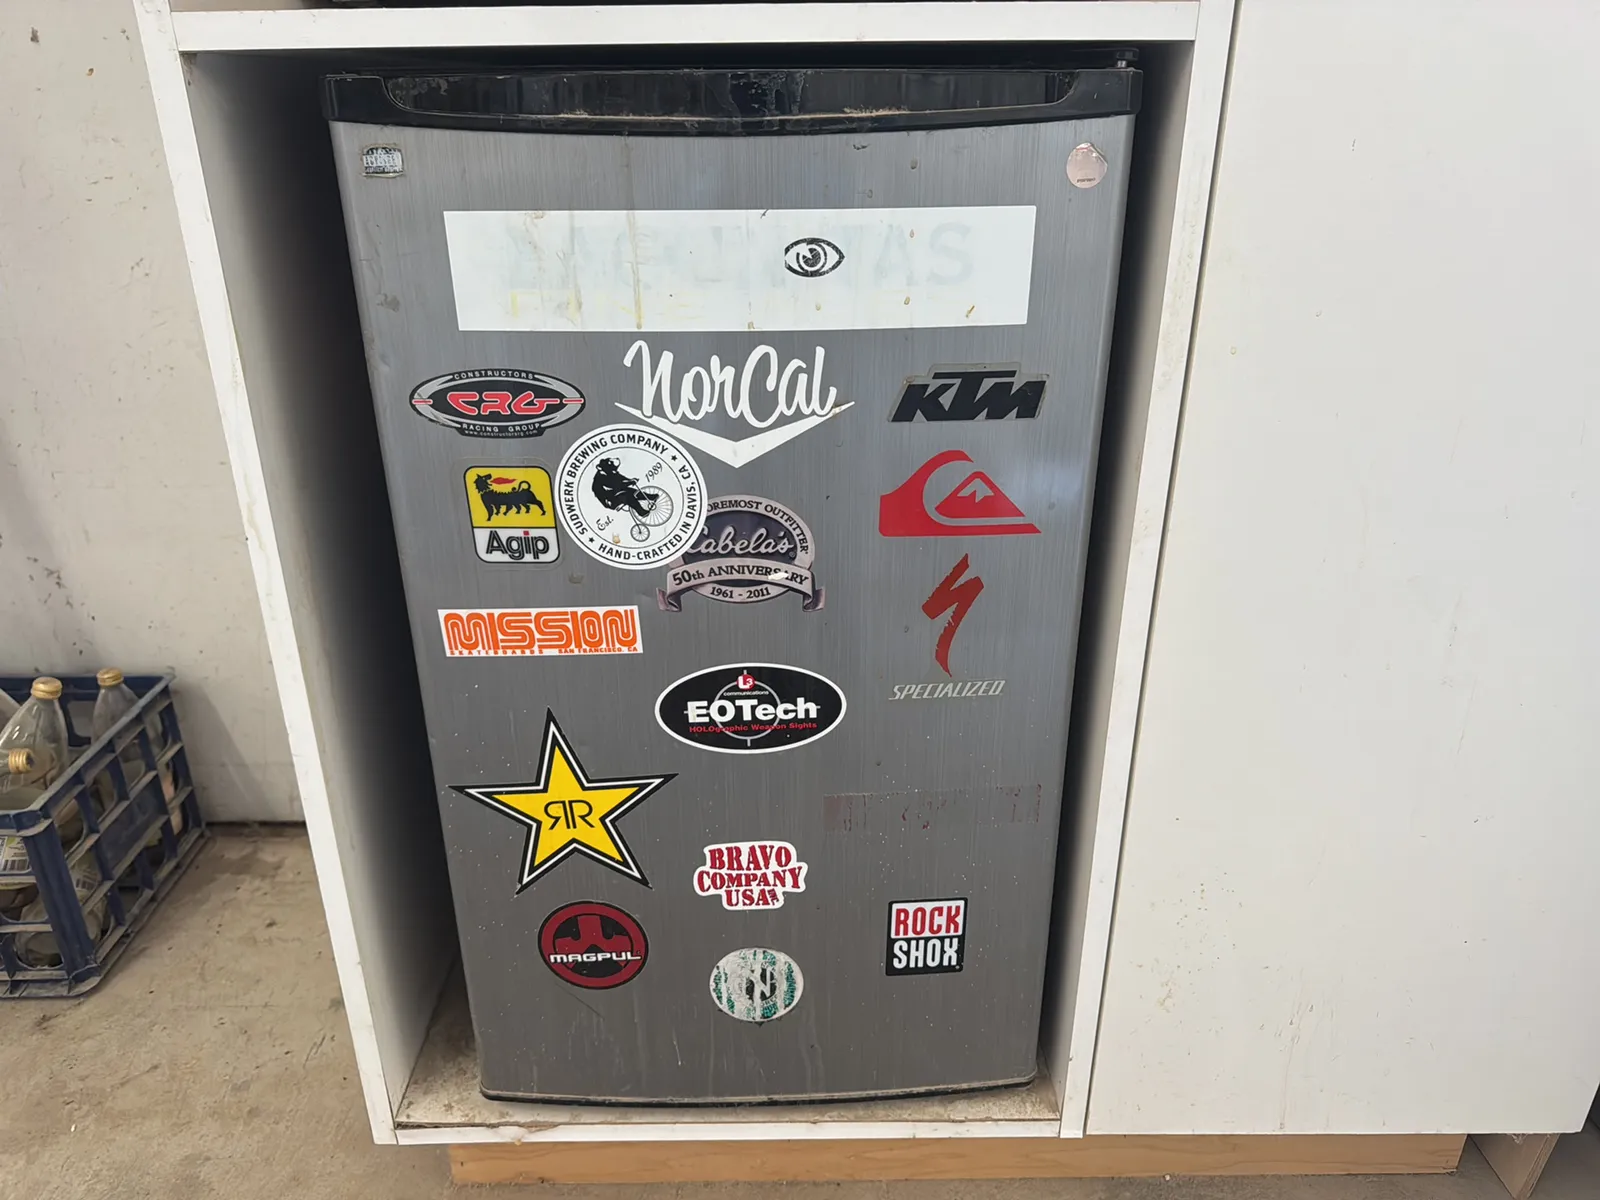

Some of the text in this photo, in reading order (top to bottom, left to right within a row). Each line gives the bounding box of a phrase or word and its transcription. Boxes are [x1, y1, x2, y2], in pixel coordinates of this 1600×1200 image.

[454, 370, 534, 380] CONSTRUCTORS
[622, 340, 838, 428] NorCal
[447, 391, 560, 415] CRG
[891, 370, 1047, 422] KTM
[462, 422, 540, 433] RACING GROUP
[563, 433, 669, 536] SUDWERK BREWING COMPANY
[644, 462, 664, 483] 1989
[678, 464, 692, 481] CA
[679, 521, 692, 535] IN
[706, 499, 809, 553] OREMOST OUTFITTER
[485, 530, 550, 560] Agip
[598, 532, 683, 561] HAND-CRAFTED
[672, 569, 704, 586] 50th
[710, 586, 734, 599] 1961
[746, 587, 771, 599] 2011
[443, 608, 638, 651] MISSION
[888, 680, 1006, 700] SPECIALIZED
[687, 697, 818, 723] EOTech
[751, 723, 787, 731] Weapon
[789, 722, 818, 730] Sights
[708, 844, 792, 871] BRAVO
[697, 866, 803, 892] COMPANY
[725, 887, 771, 907] USA
[894, 905, 961, 936] ROCK
[550, 951, 642, 963] MAGPUL
[893, 937, 959, 969] SHOX
